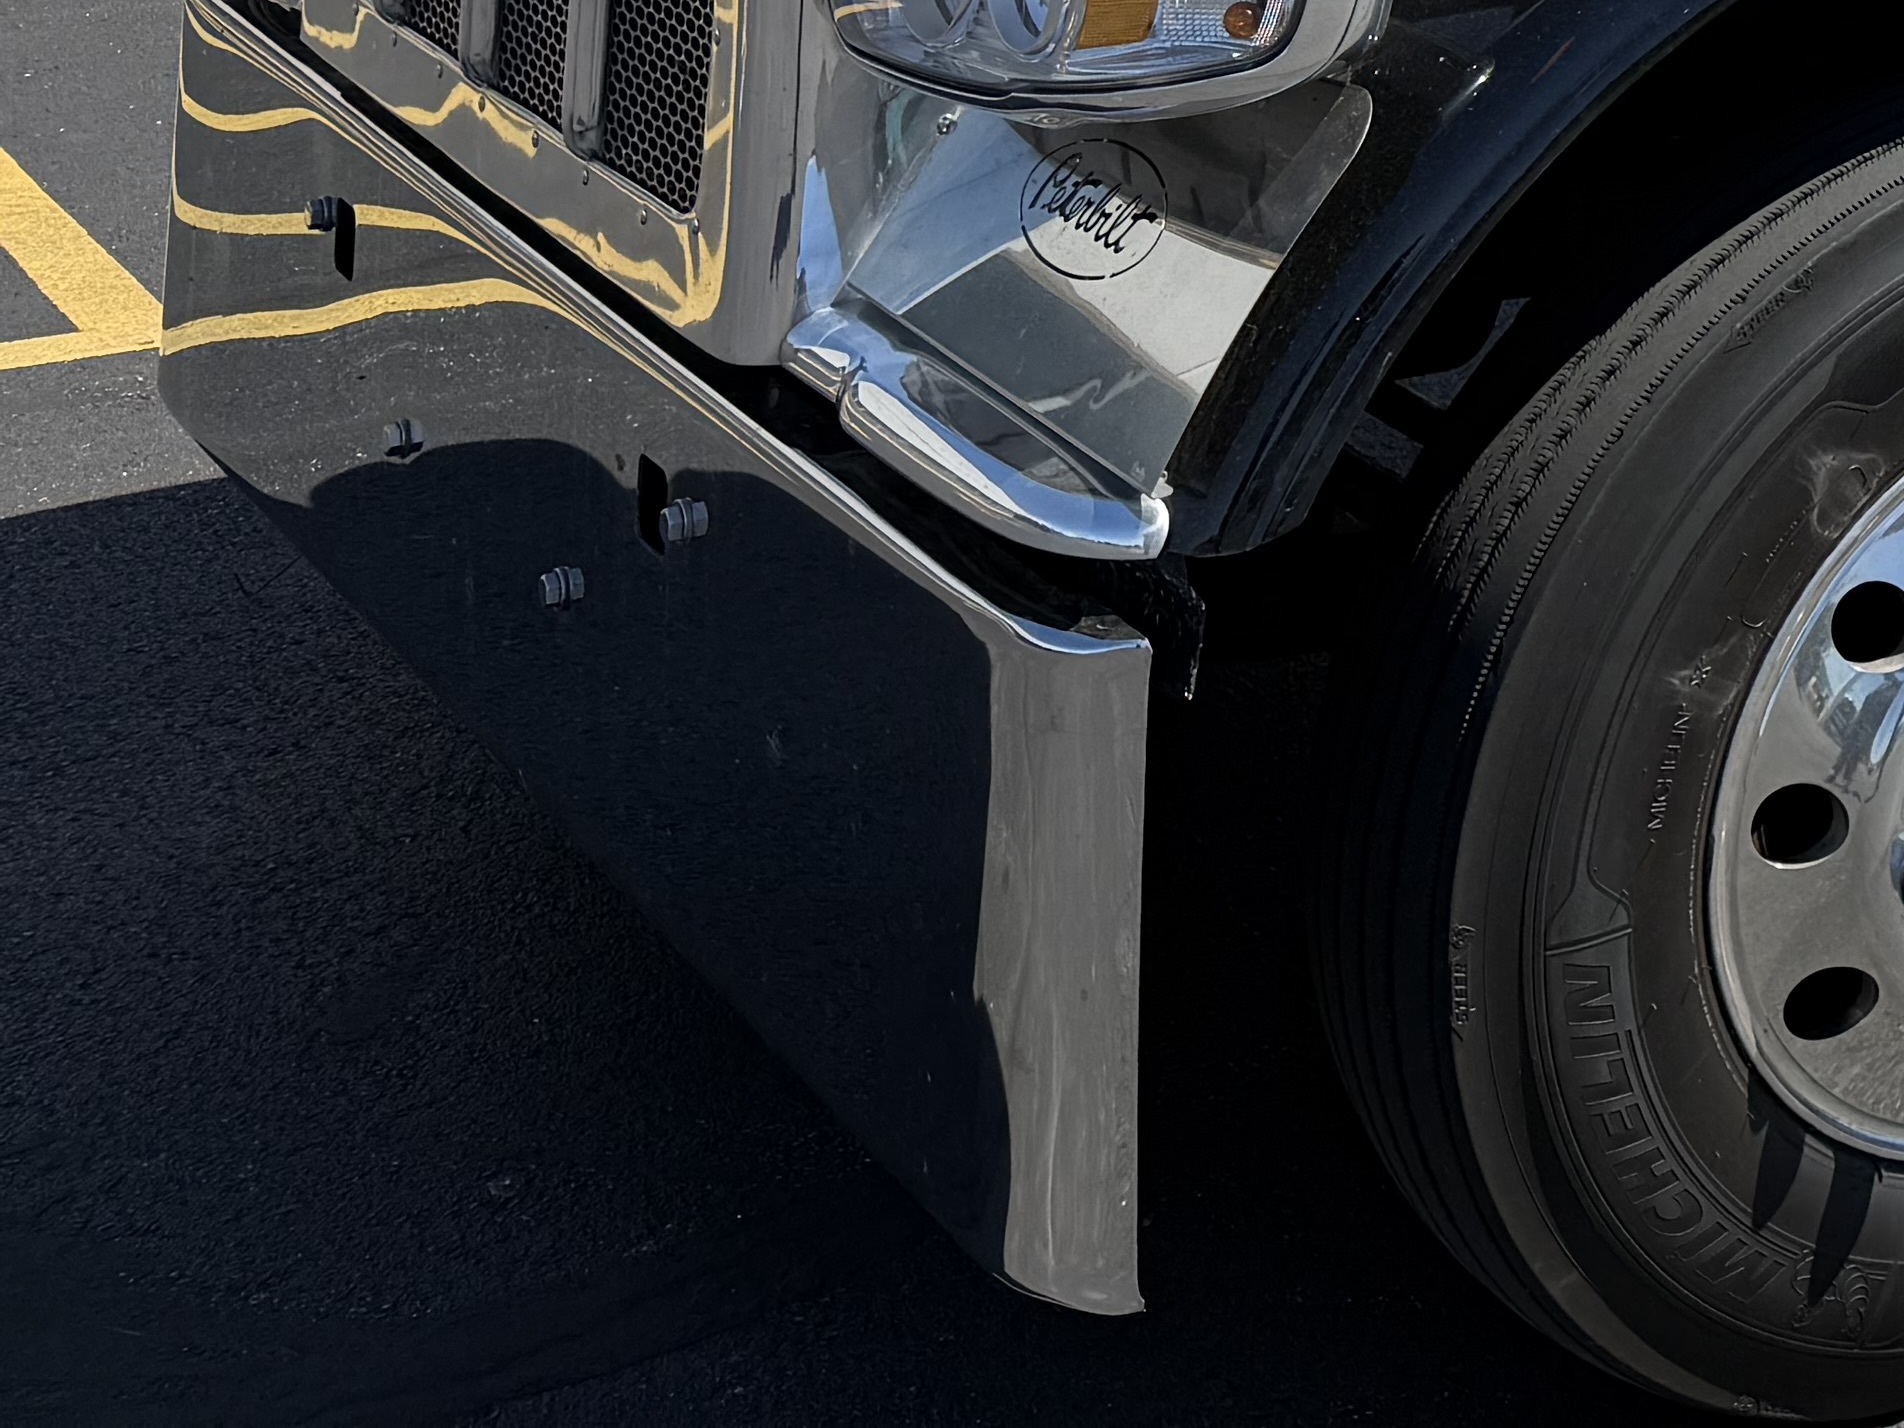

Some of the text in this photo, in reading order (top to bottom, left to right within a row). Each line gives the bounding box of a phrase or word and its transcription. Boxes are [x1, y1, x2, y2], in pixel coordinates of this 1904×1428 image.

[1028, 152, 1158, 254] Peterbilt
[1646, 710, 1693, 831] MICHELIN
[1563, 963, 1788, 1304] MICHELIN
